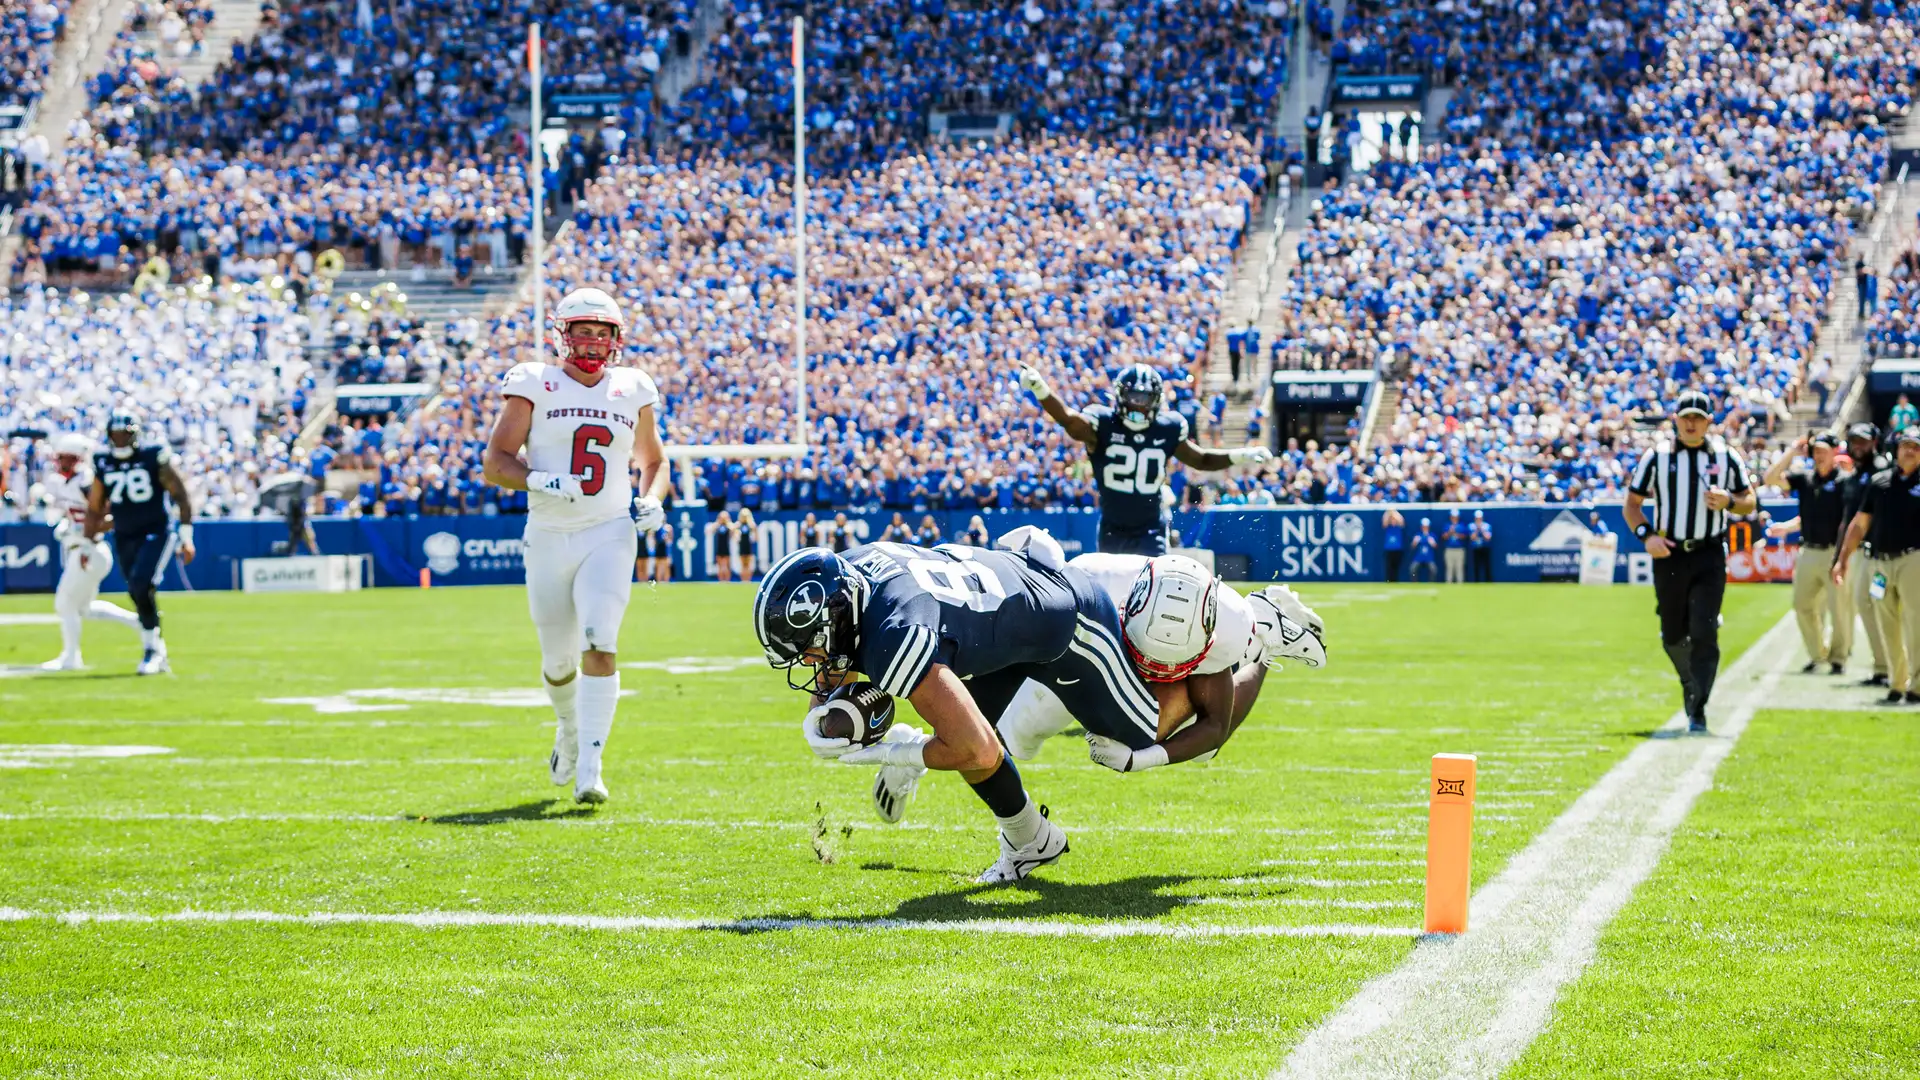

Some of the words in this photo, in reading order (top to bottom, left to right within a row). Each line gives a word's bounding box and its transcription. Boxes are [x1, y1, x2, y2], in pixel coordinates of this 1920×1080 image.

[1342, 85, 1380, 97] Portal
[1288, 383, 1331, 398] Portal
[546, 407, 607, 420] SOUTHERN
[570, 423, 614, 496] 6
[1103, 443, 1167, 495] 20
[103, 468, 154, 504] 78
[1281, 514, 1332, 546] NU
[1281, 545, 1363, 577] SKIN
